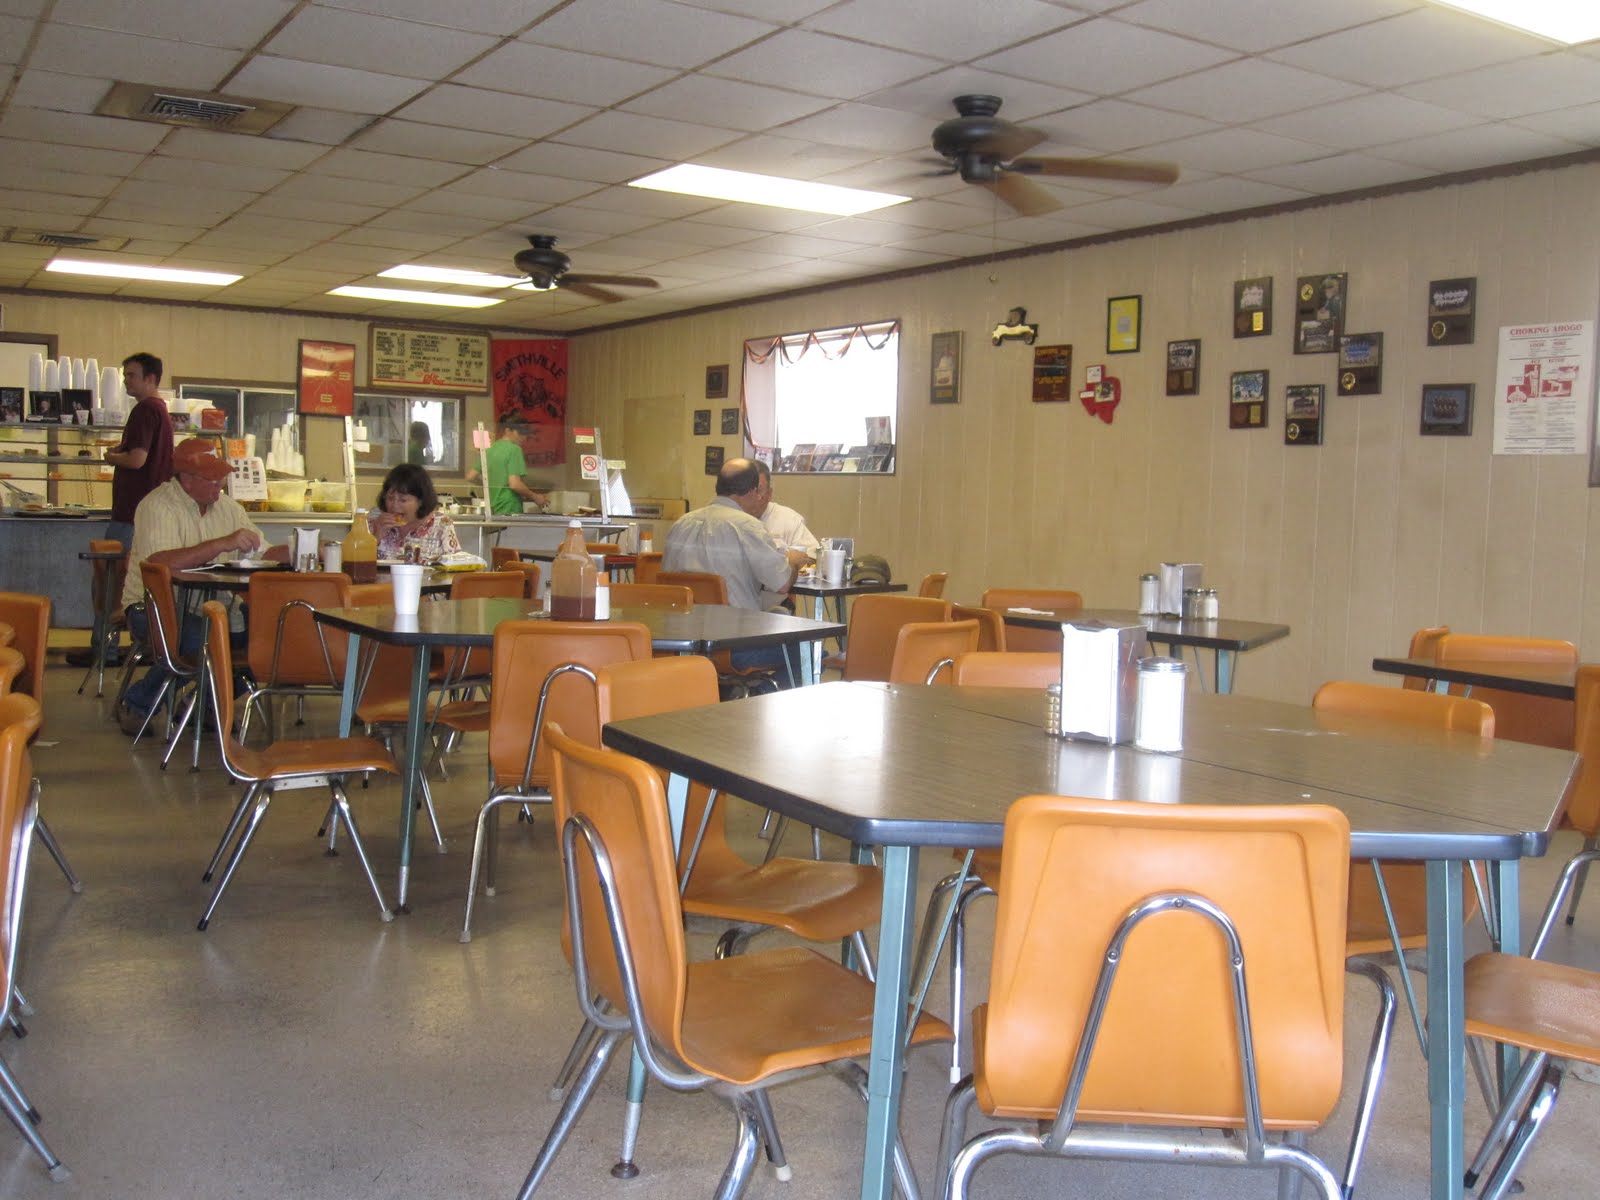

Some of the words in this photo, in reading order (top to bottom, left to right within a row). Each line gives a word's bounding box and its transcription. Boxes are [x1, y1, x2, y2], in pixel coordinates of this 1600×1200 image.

[1510, 326, 1549, 336] CHOKING
[1553, 324, 1583, 333] AHOGO
[496, 352, 565, 381] SMITHVILLE
